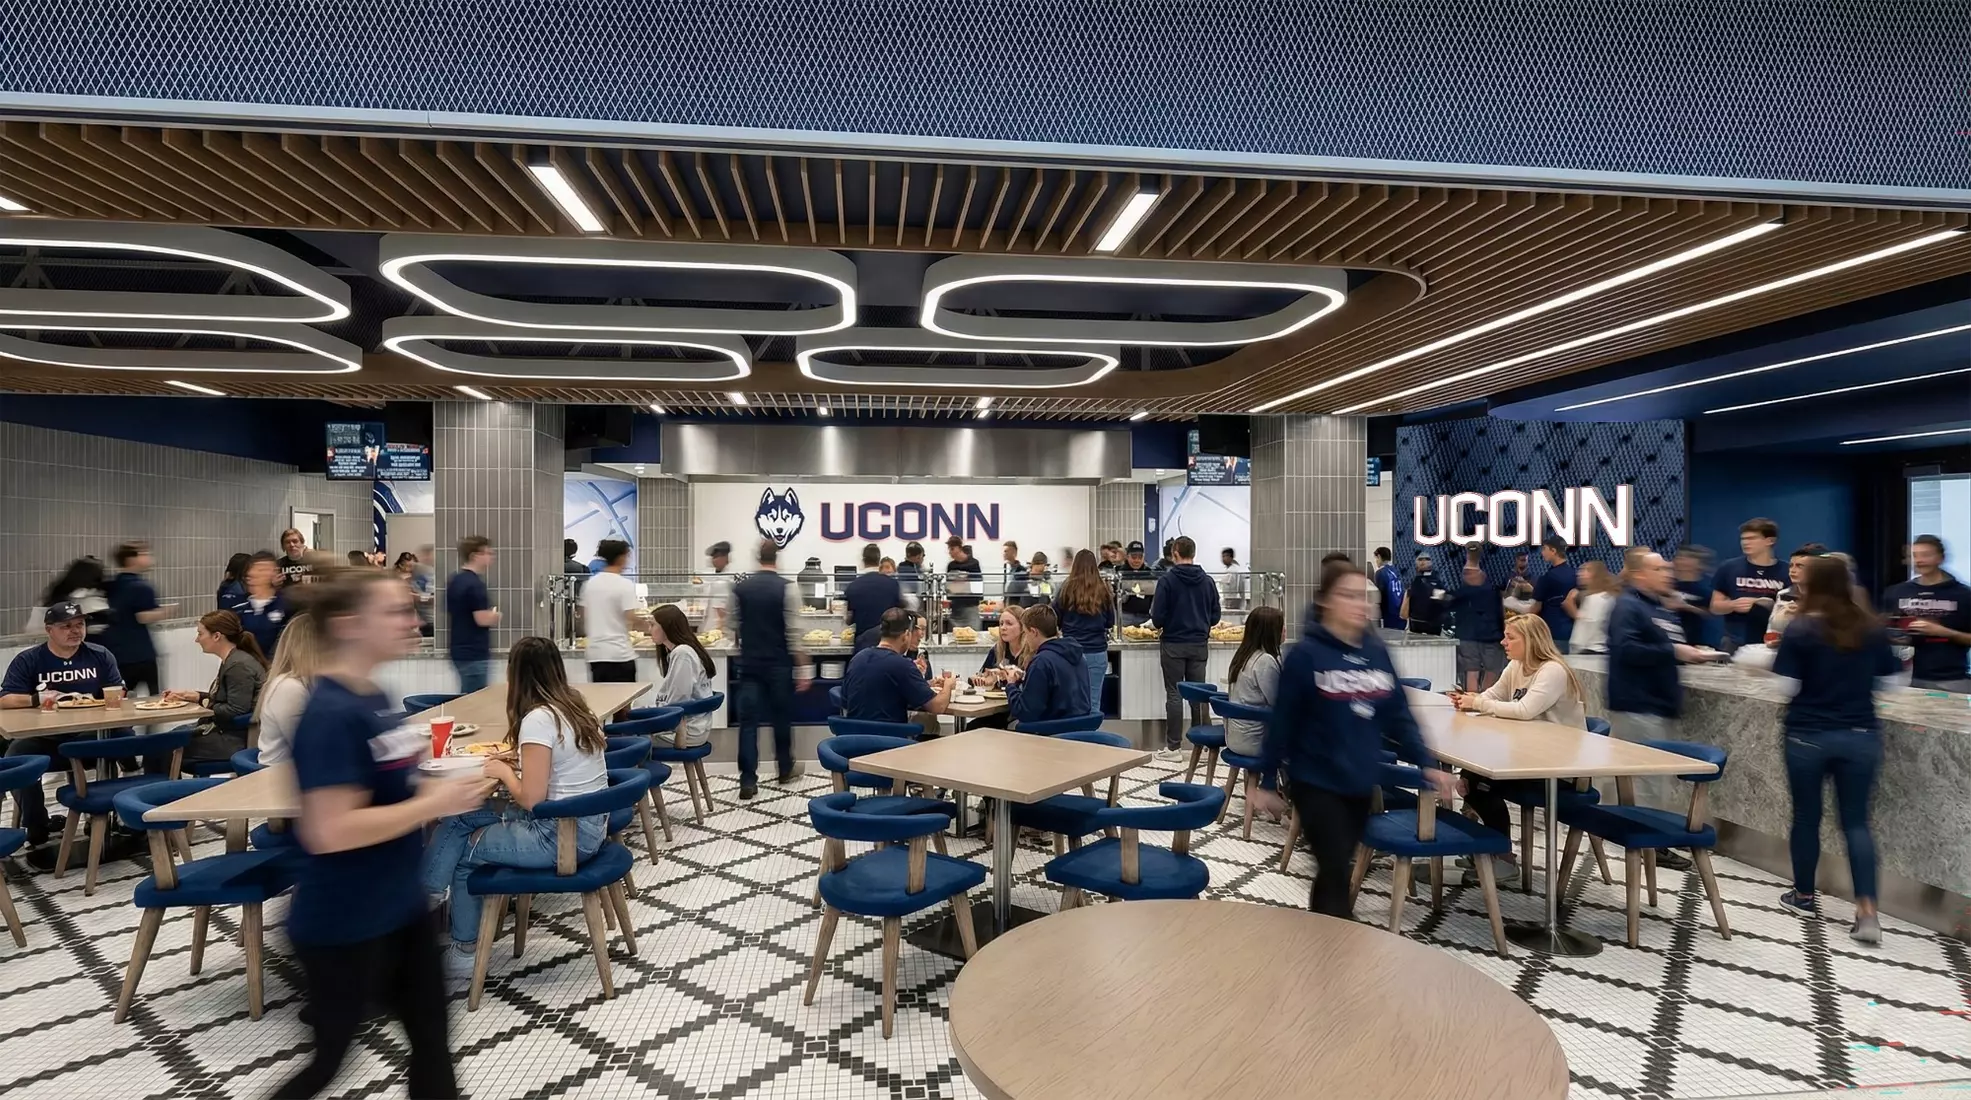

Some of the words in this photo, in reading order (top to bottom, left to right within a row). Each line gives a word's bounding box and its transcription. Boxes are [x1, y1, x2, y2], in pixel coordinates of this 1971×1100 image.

[820, 502, 1000, 541] UCONN
[1413, 484, 1634, 547] UCONN
[38, 667, 97, 683] UCONN
